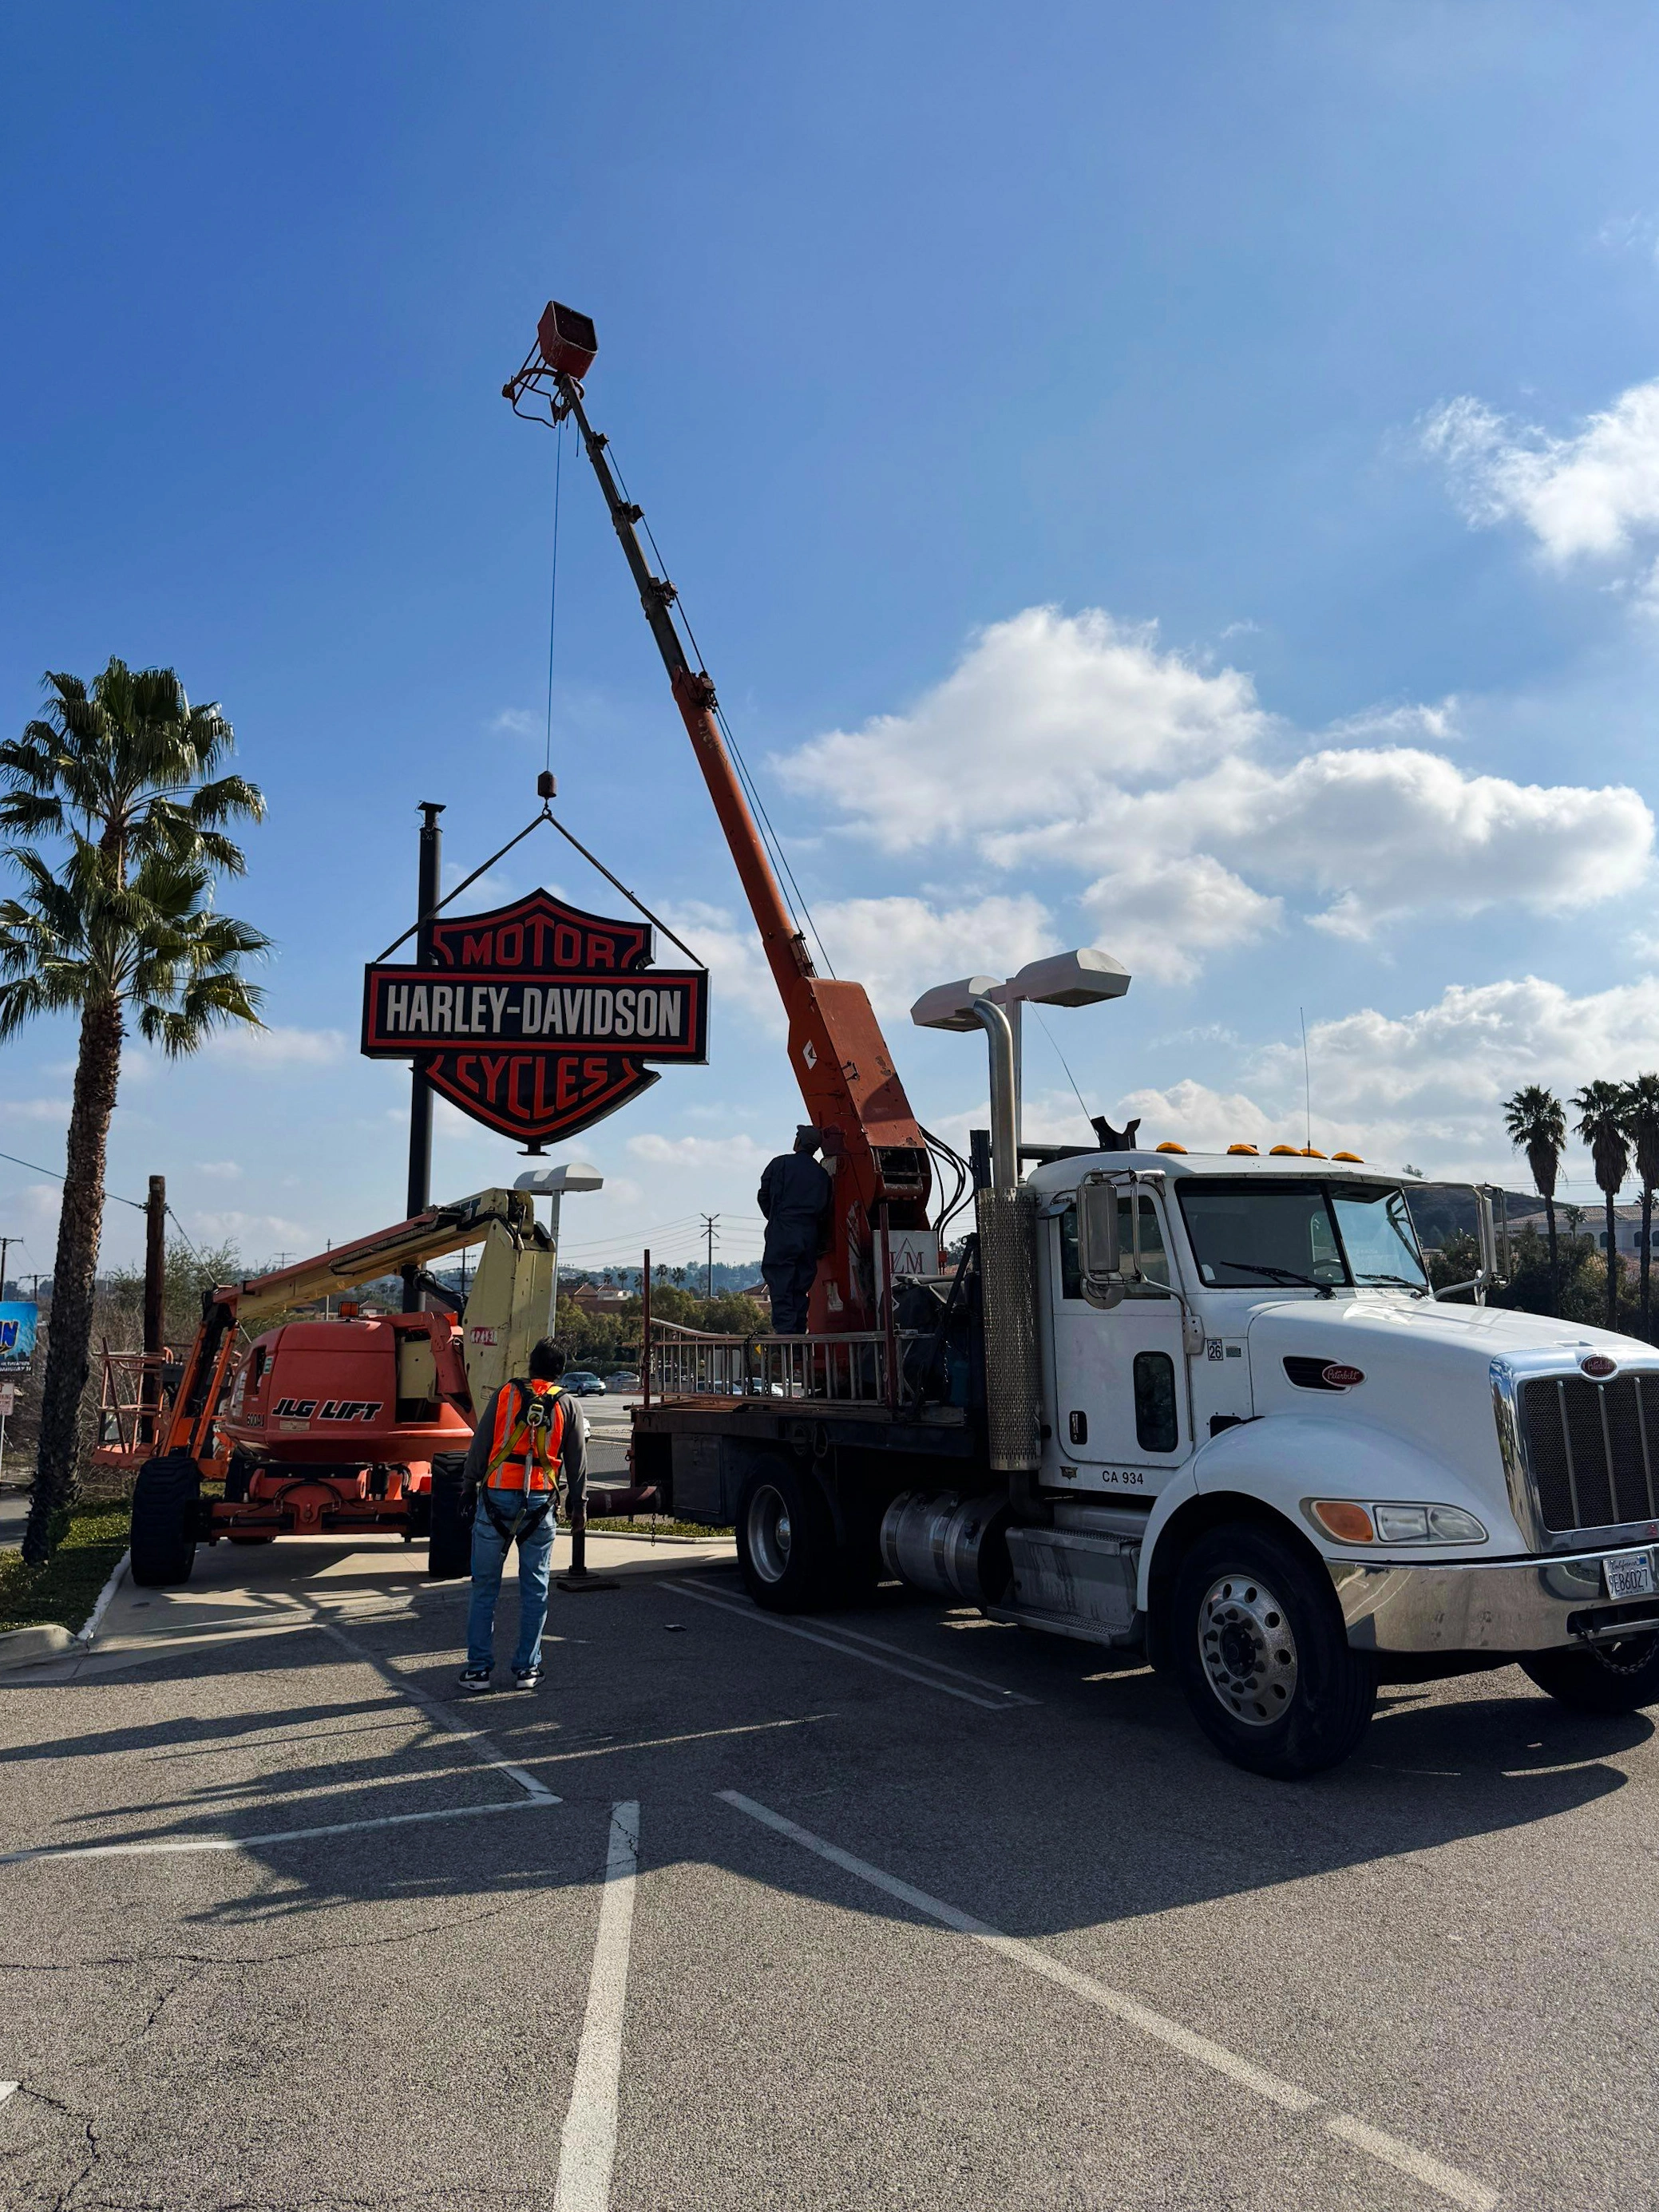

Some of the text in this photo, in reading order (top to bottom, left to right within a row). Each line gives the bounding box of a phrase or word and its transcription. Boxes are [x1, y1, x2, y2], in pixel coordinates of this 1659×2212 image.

[462, 912, 616, 968] MOTOR
[386, 984, 682, 1038] HARLEY-DAVIDSON
[456, 1055, 608, 1119] CYCLES
[1209, 1345, 1221, 1359] 26
[1327, 1368, 1360, 1380] Peterbilt
[271, 1398, 383, 1421] JLG LIFT
[1102, 1470, 1144, 1485] CA 934
